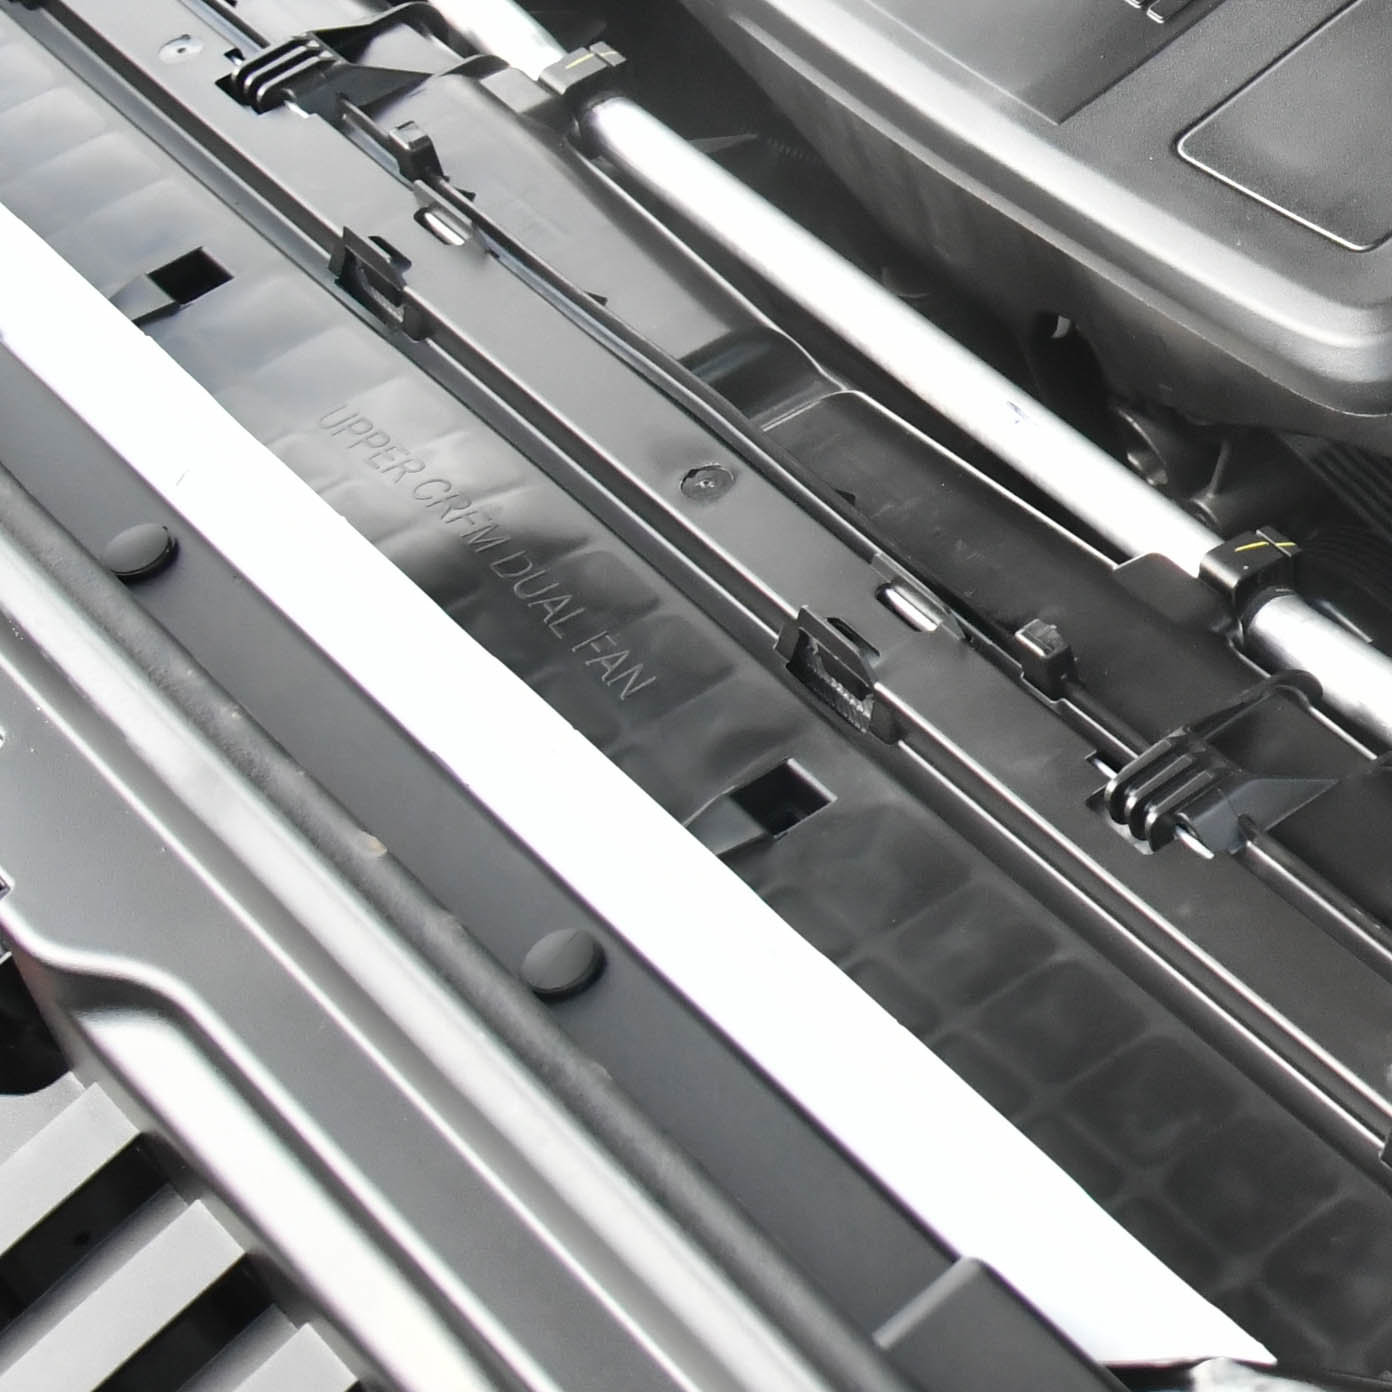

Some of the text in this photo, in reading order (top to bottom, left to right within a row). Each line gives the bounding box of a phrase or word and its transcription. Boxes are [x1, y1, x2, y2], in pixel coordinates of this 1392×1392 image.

[318, 406, 657, 701] UPPER CRFM DUAL FAN
